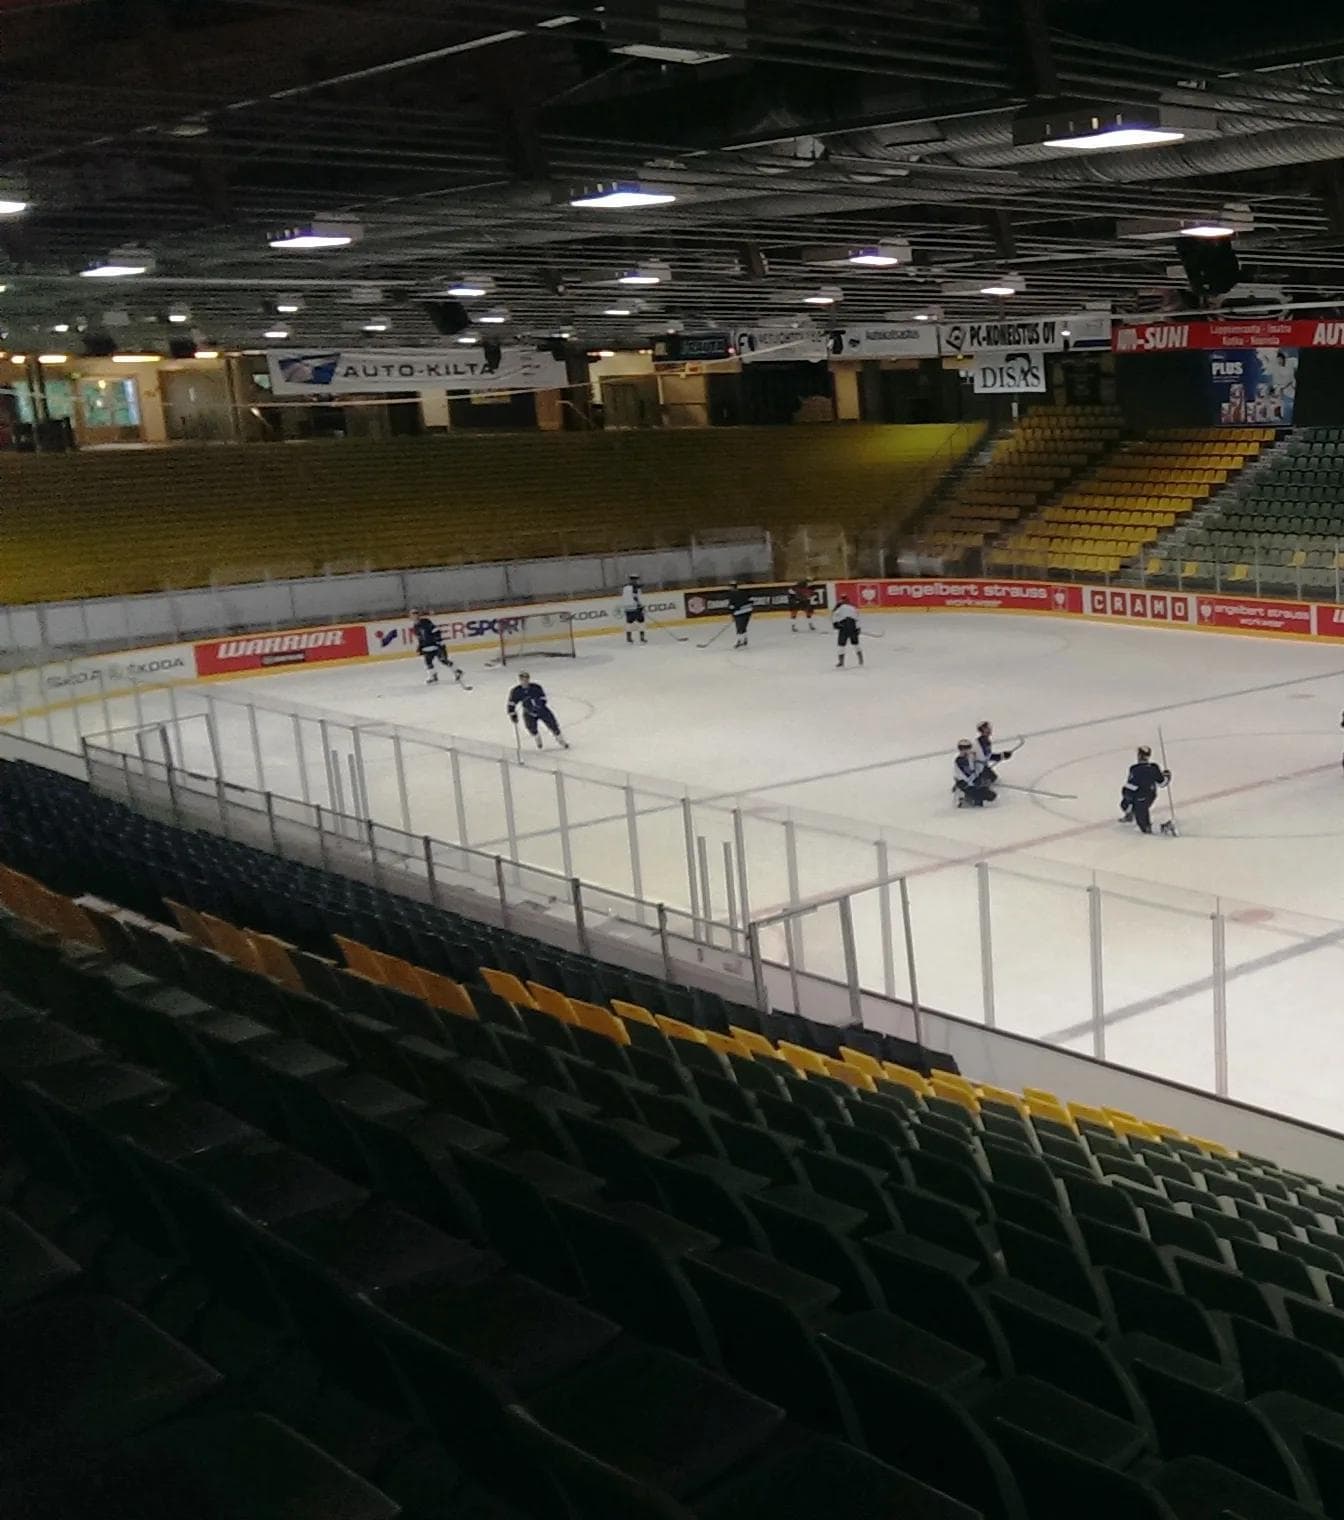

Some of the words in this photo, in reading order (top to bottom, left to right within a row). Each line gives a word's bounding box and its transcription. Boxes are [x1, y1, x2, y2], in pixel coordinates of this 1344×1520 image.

[344, 362, 497, 378] AUTO-KILTA
[1212, 362, 1243, 375] PLUS
[887, 583, 978, 598] engelbert
[984, 584, 1047, 598] strauss
[1094, 595, 1185, 618] CRAMO
[1215, 604, 1265, 617] engelbert
[1267, 608, 1309, 620] strauss
[217, 630, 345, 659] WARRIOR
